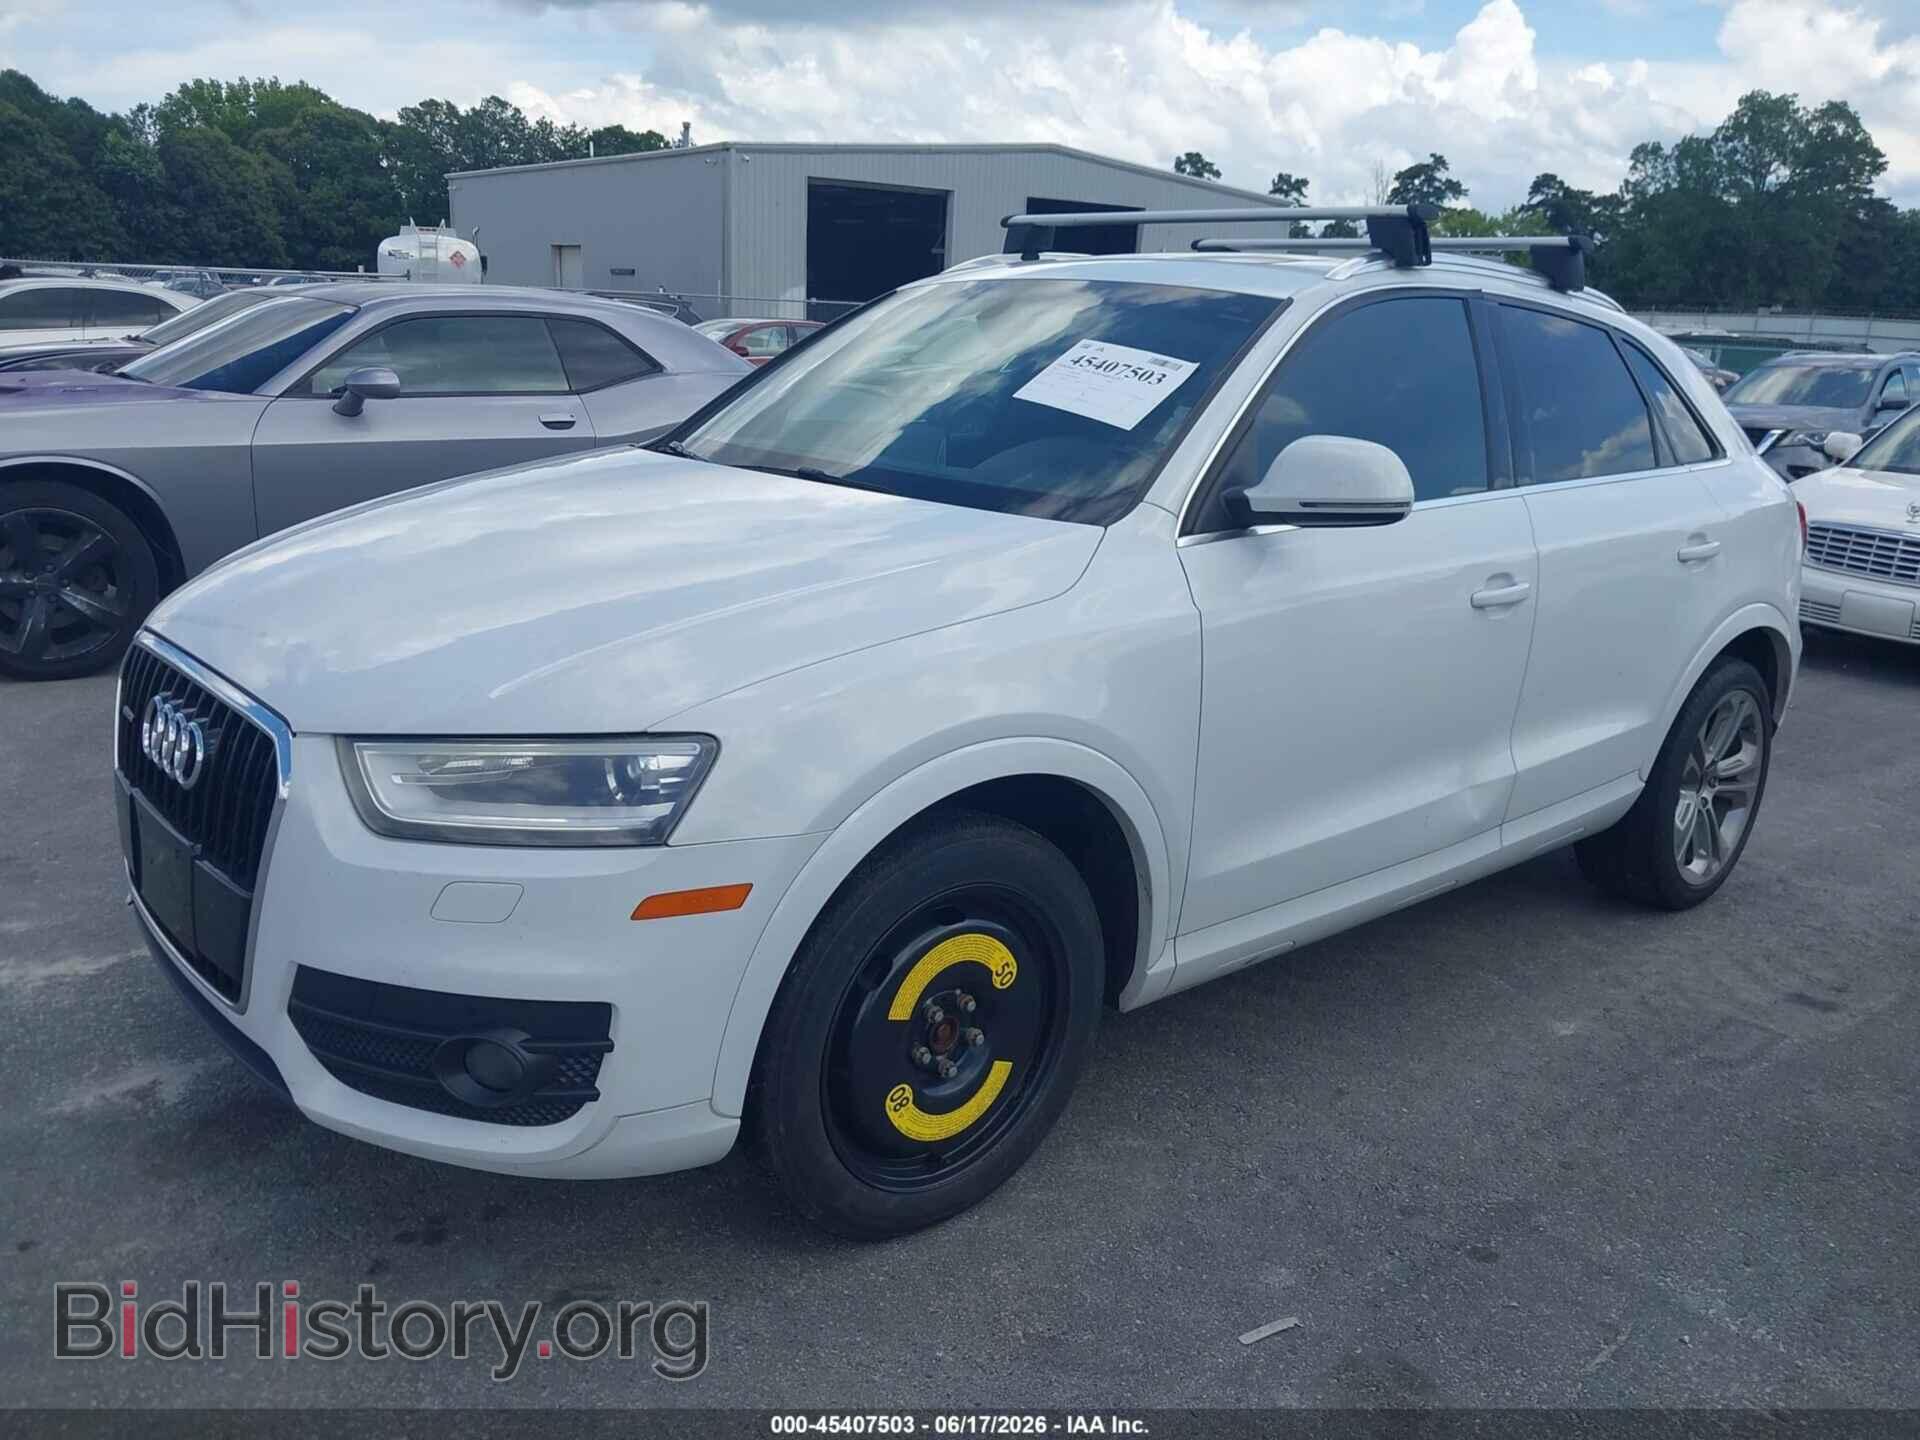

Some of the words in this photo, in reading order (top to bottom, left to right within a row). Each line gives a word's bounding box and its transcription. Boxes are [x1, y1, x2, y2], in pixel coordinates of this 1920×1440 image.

[1070, 354, 1168, 386] 45407503
[994, 961, 1015, 987] 50
[889, 1086, 910, 1113] 80
